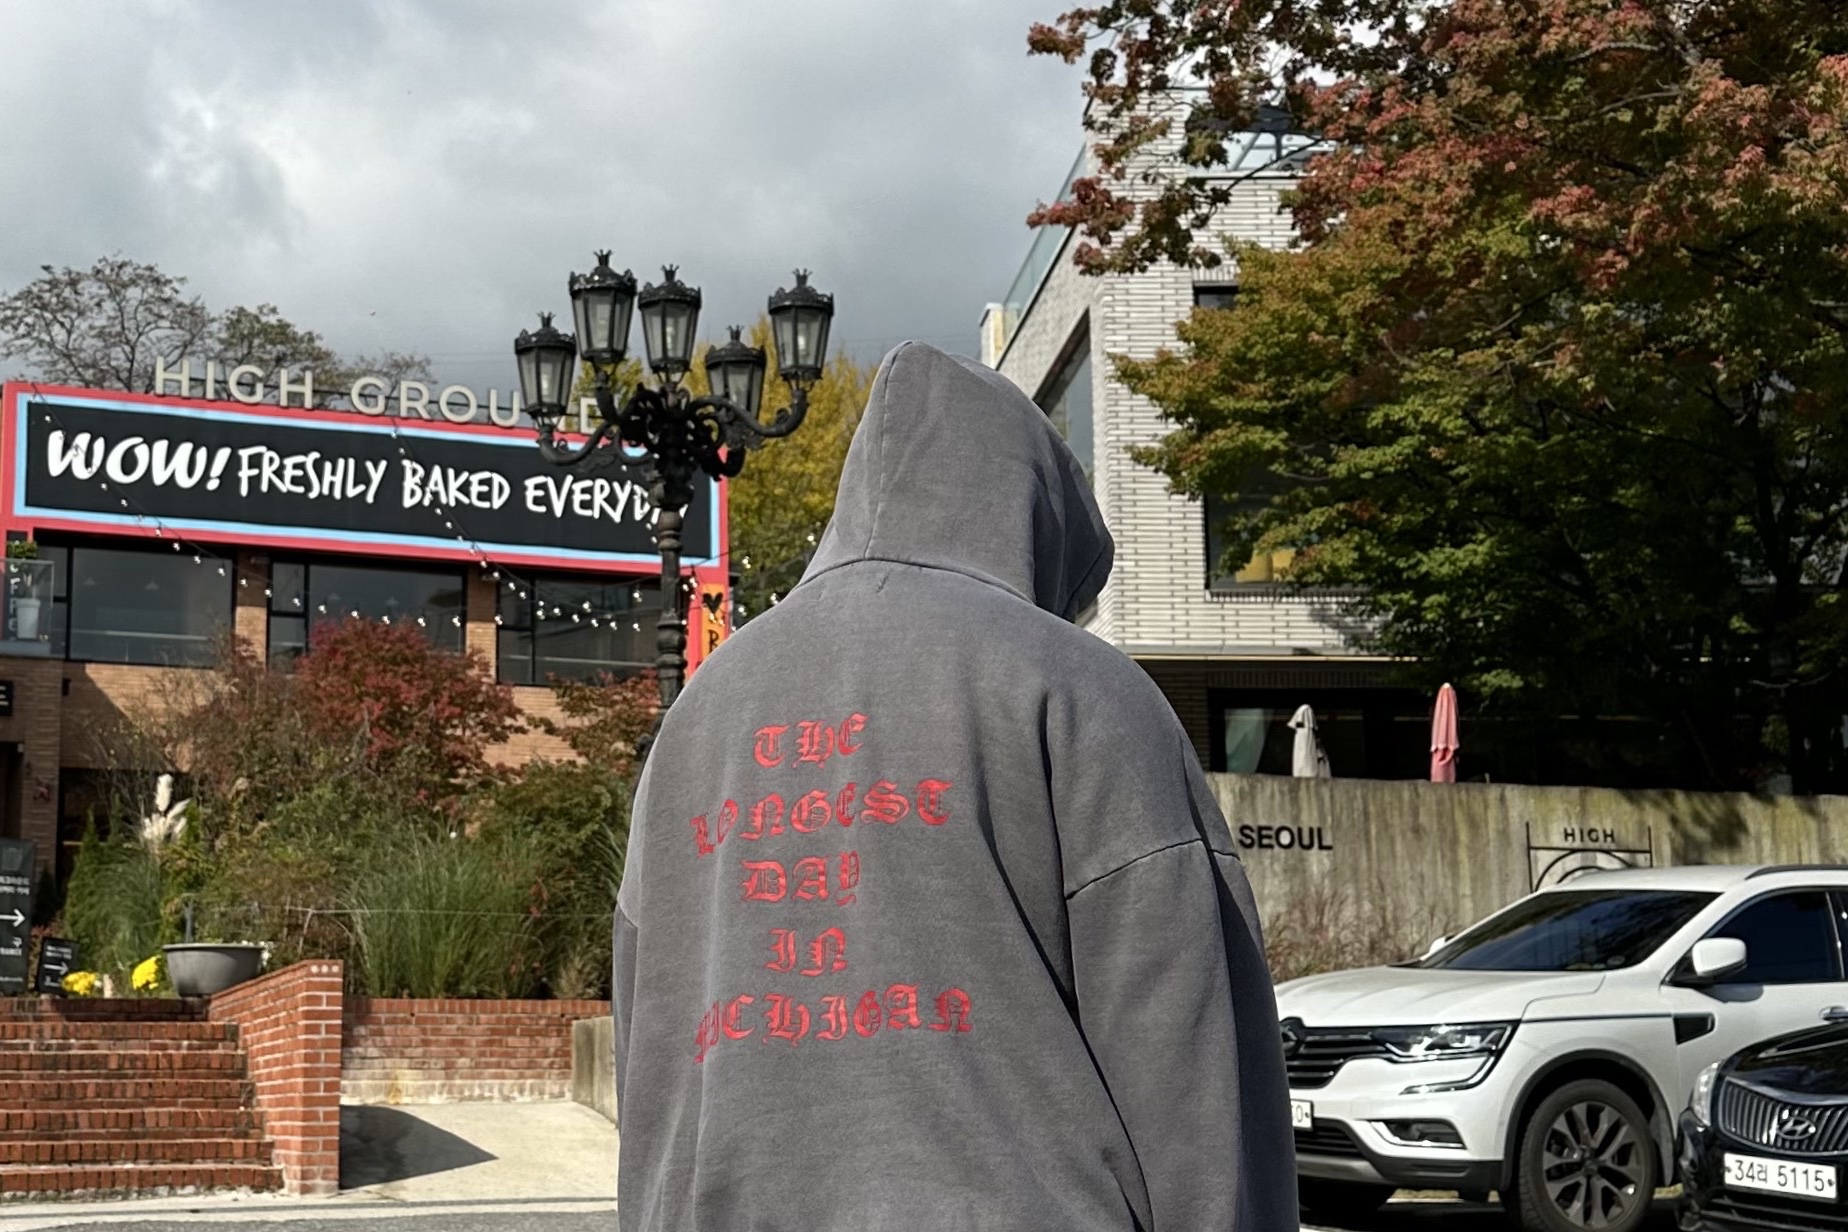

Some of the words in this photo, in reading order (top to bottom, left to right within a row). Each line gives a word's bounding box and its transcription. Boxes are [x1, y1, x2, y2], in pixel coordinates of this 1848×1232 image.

[155, 355, 314, 410] HIGH
[351, 376, 620, 435] GROUD
[47, 429, 232, 491] WOW!
[237, 445, 387, 504] FRESHLY
[402, 459, 511, 510] BAKED
[523, 474, 689, 526] EVERYD
[753, 712, 868, 769] THE
[1238, 824, 1334, 851] SEOUL
[1563, 827, 1616, 843] HIGH
[740, 851, 860, 906] DAY
[763, 927, 848, 976] IN
[1777, 1165, 1826, 1192] 5115
